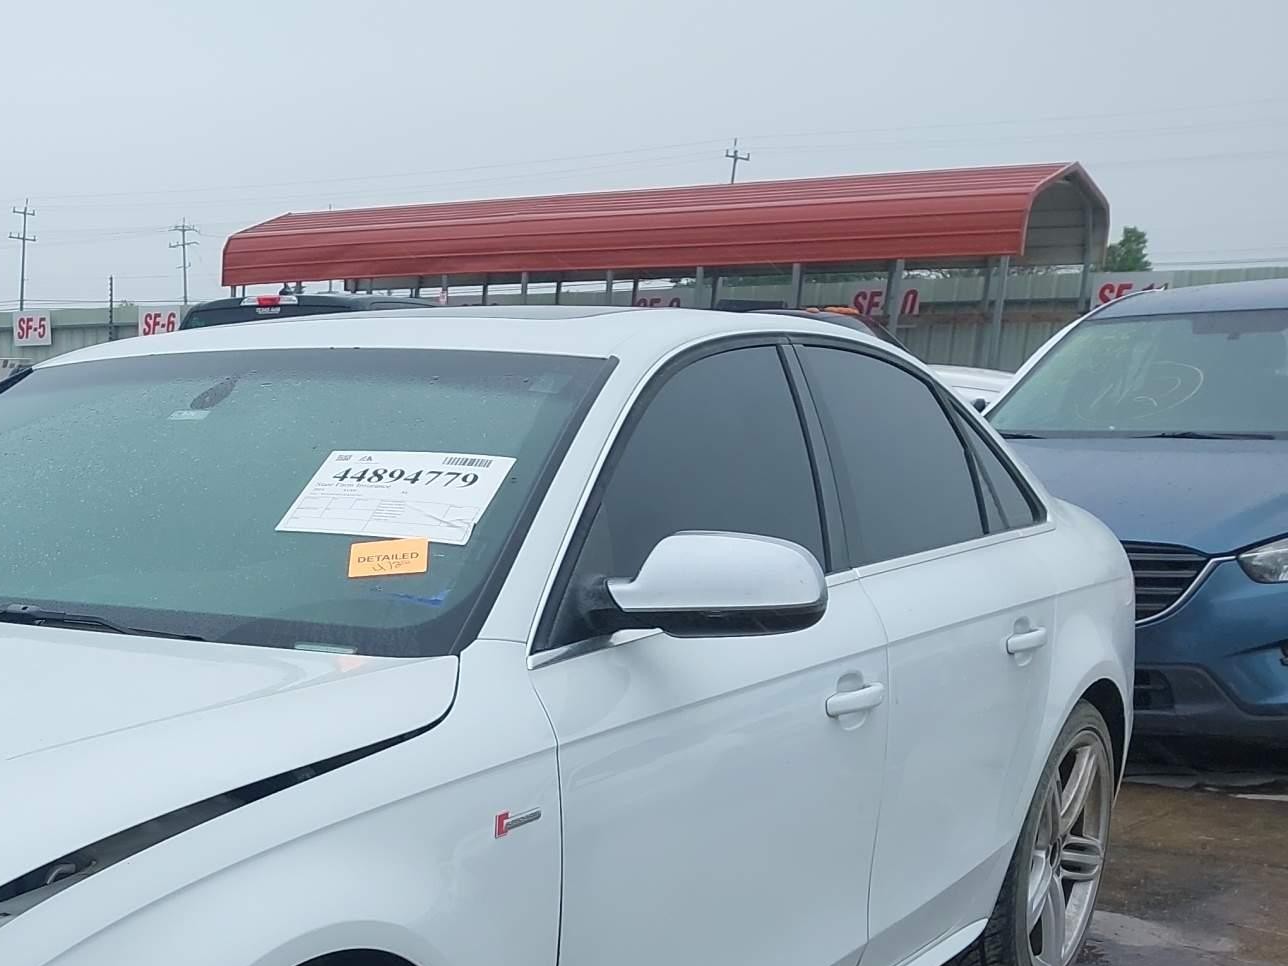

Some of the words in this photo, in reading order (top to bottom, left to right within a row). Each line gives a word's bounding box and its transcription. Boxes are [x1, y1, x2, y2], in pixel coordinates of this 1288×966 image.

[17, 317, 46, 340] SF-5
[143, 312, 176, 336] SF-6
[332, 467, 479, 488] 44894779
[357, 551, 420, 563] DETAILED
